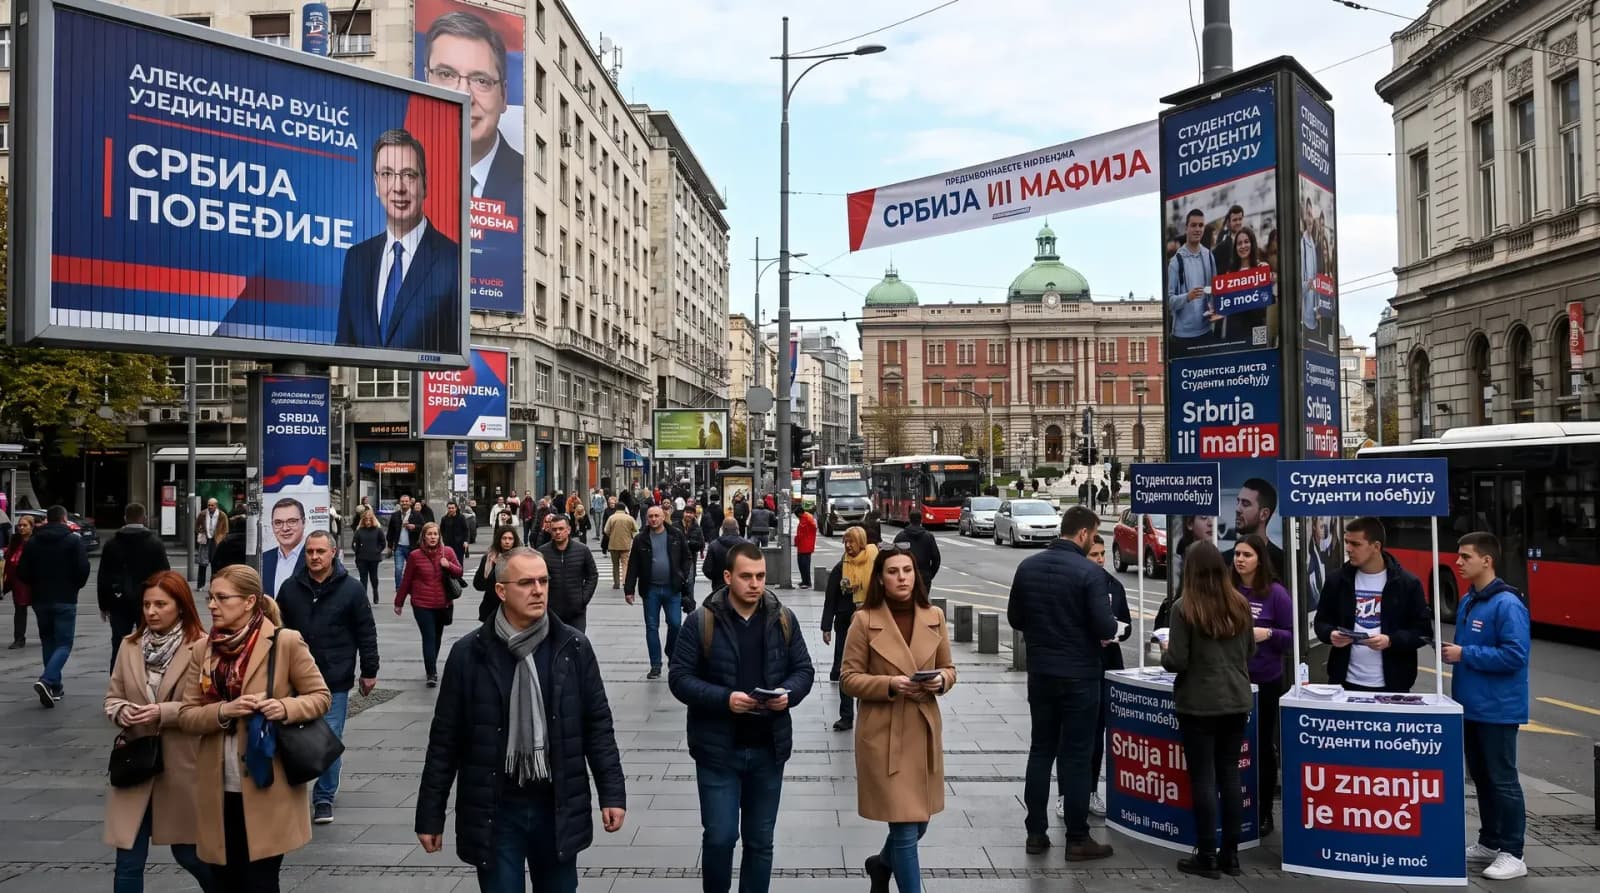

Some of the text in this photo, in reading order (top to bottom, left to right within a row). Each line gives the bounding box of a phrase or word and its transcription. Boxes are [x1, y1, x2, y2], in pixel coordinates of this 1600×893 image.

[129, 63, 284, 111] АЛЕКСАНДАР
[1178, 105, 1261, 140] СТУДЕНТСКА
[281, 120, 358, 149] СРБИЈА
[1178, 121, 1261, 158] СТУДЕНТИ
[1179, 142, 1262, 177] ПОБЕЂУЈУ
[128, 143, 297, 201] СРБИЈА
[884, 188, 981, 228] СРБИЈА
[1020, 149, 1152, 201] МАФИЈА
[1215, 272, 1267, 290] U znanju
[1219, 290, 1259, 311] je moć
[1181, 362, 1267, 379] Студентска листа
[1181, 374, 1270, 392] Студенти побеђују
[428, 396, 467, 408] SRBIJA
[279, 413, 319, 423] SRBIJA
[1177, 428, 1275, 458] ili mafija
[1315, 429, 1338, 458] mafija
[1135, 474, 1213, 488] Студентска листа
[1290, 472, 1434, 488] Студентска листа
[1136, 489, 1213, 505] Студенти побеђују
[1290, 487, 1436, 505] Студенти побеђују
[1110, 686, 1159, 707] Студентска
[1110, 702, 1145, 720] Студенти
[1299, 714, 1443, 734] Студентска листа
[1112, 732, 1161, 769] Srbija
[1299, 732, 1442, 755] Студенти побеђују
[1119, 769, 1179, 803] mafija
[1304, 766, 1440, 805] U znanju
[1120, 809, 1179, 836] Srbija ili mafija
[1304, 797, 1412, 831] je moć
[1321, 848, 1428, 868] U znanju je moć
